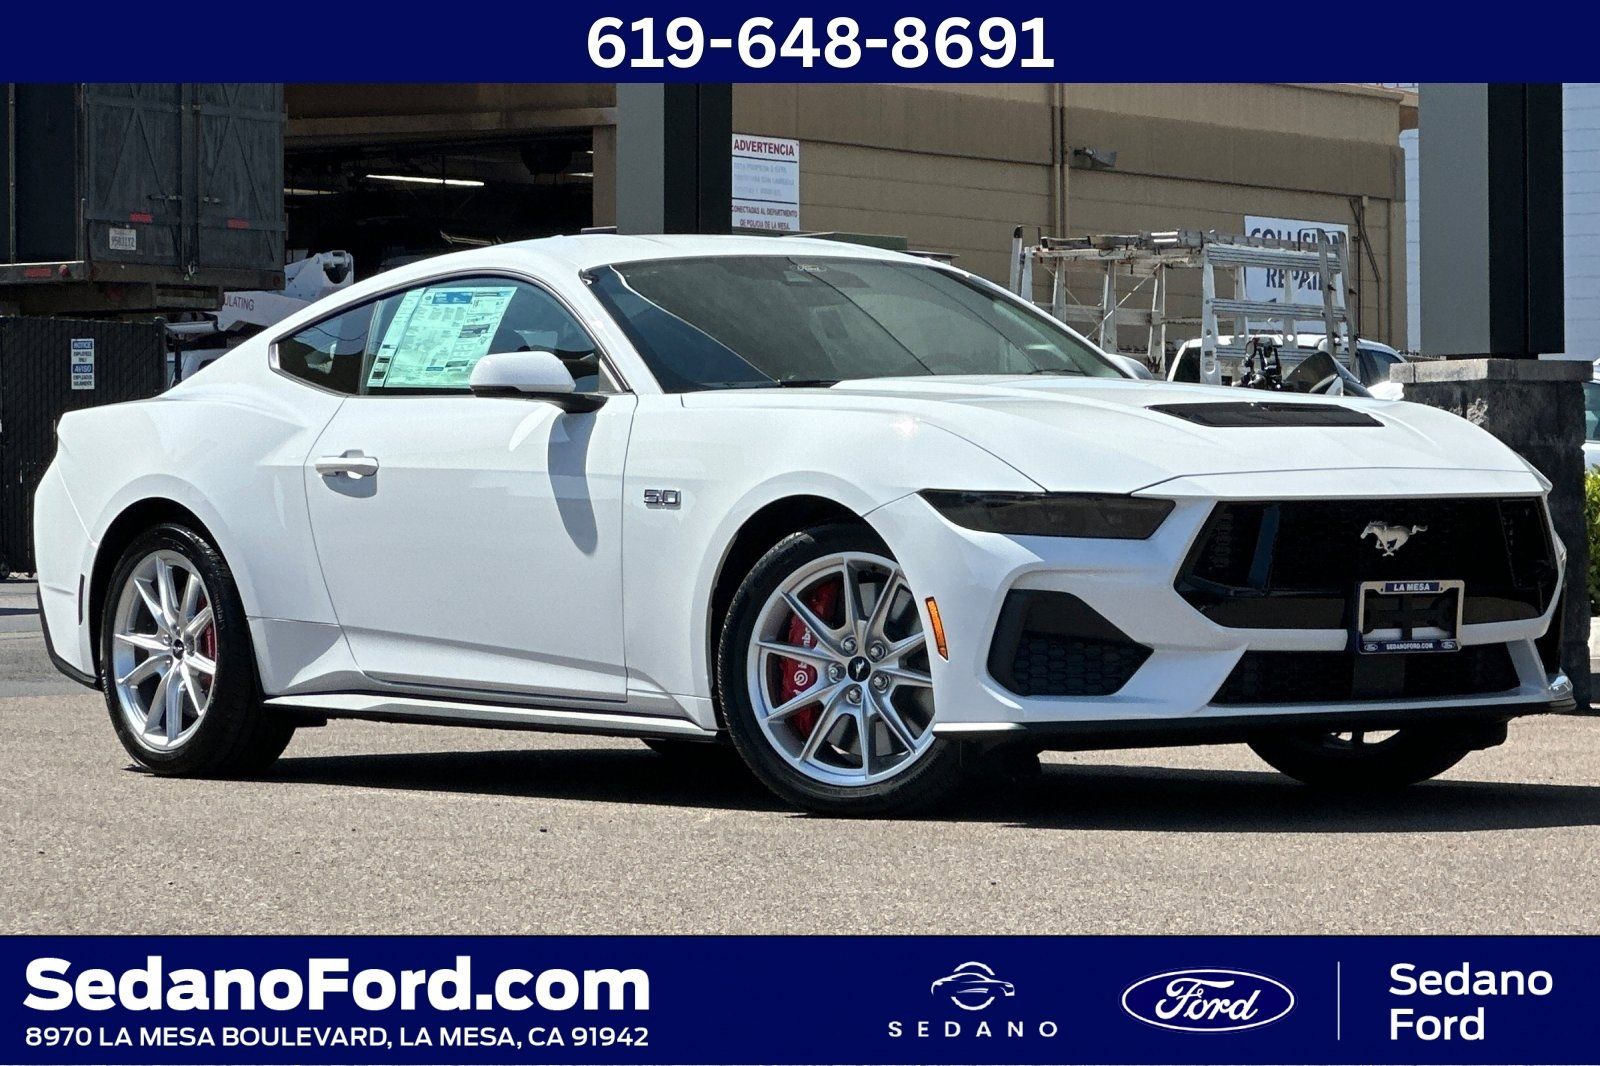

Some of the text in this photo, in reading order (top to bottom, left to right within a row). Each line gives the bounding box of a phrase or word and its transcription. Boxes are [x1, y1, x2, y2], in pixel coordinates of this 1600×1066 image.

[734, 139, 795, 156] ADVERTENCIA
[1265, 268, 1324, 291] REPAI
[73, 365, 92, 373] AVISO
[644, 489, 680, 506] 5.0
[1393, 583, 1431, 592] LA MESA
[1386, 642, 1434, 651] SEDANOFORD.COM
